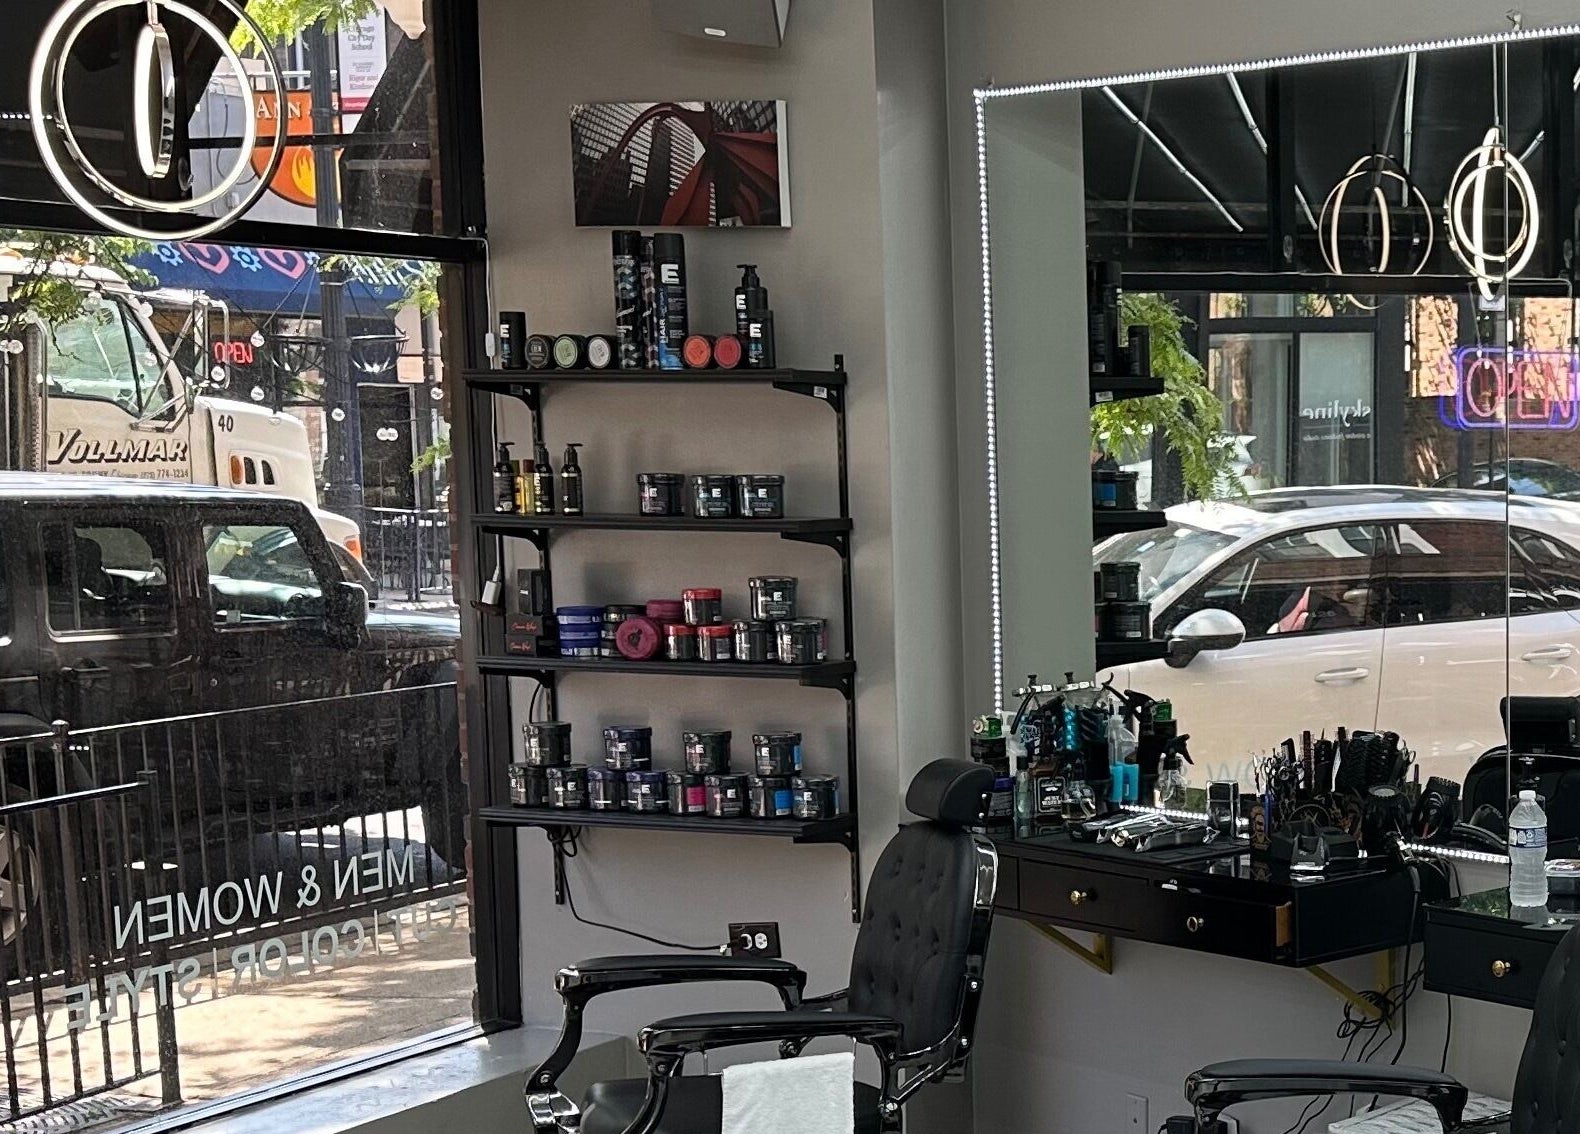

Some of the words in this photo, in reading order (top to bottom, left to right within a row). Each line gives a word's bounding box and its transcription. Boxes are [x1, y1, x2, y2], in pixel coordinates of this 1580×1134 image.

[213, 341, 253, 364] OPEN
[1466, 357, 1572, 419] OPEN
[217, 414, 234, 433] 40
[48, 428, 188, 465] VOLLMAR
